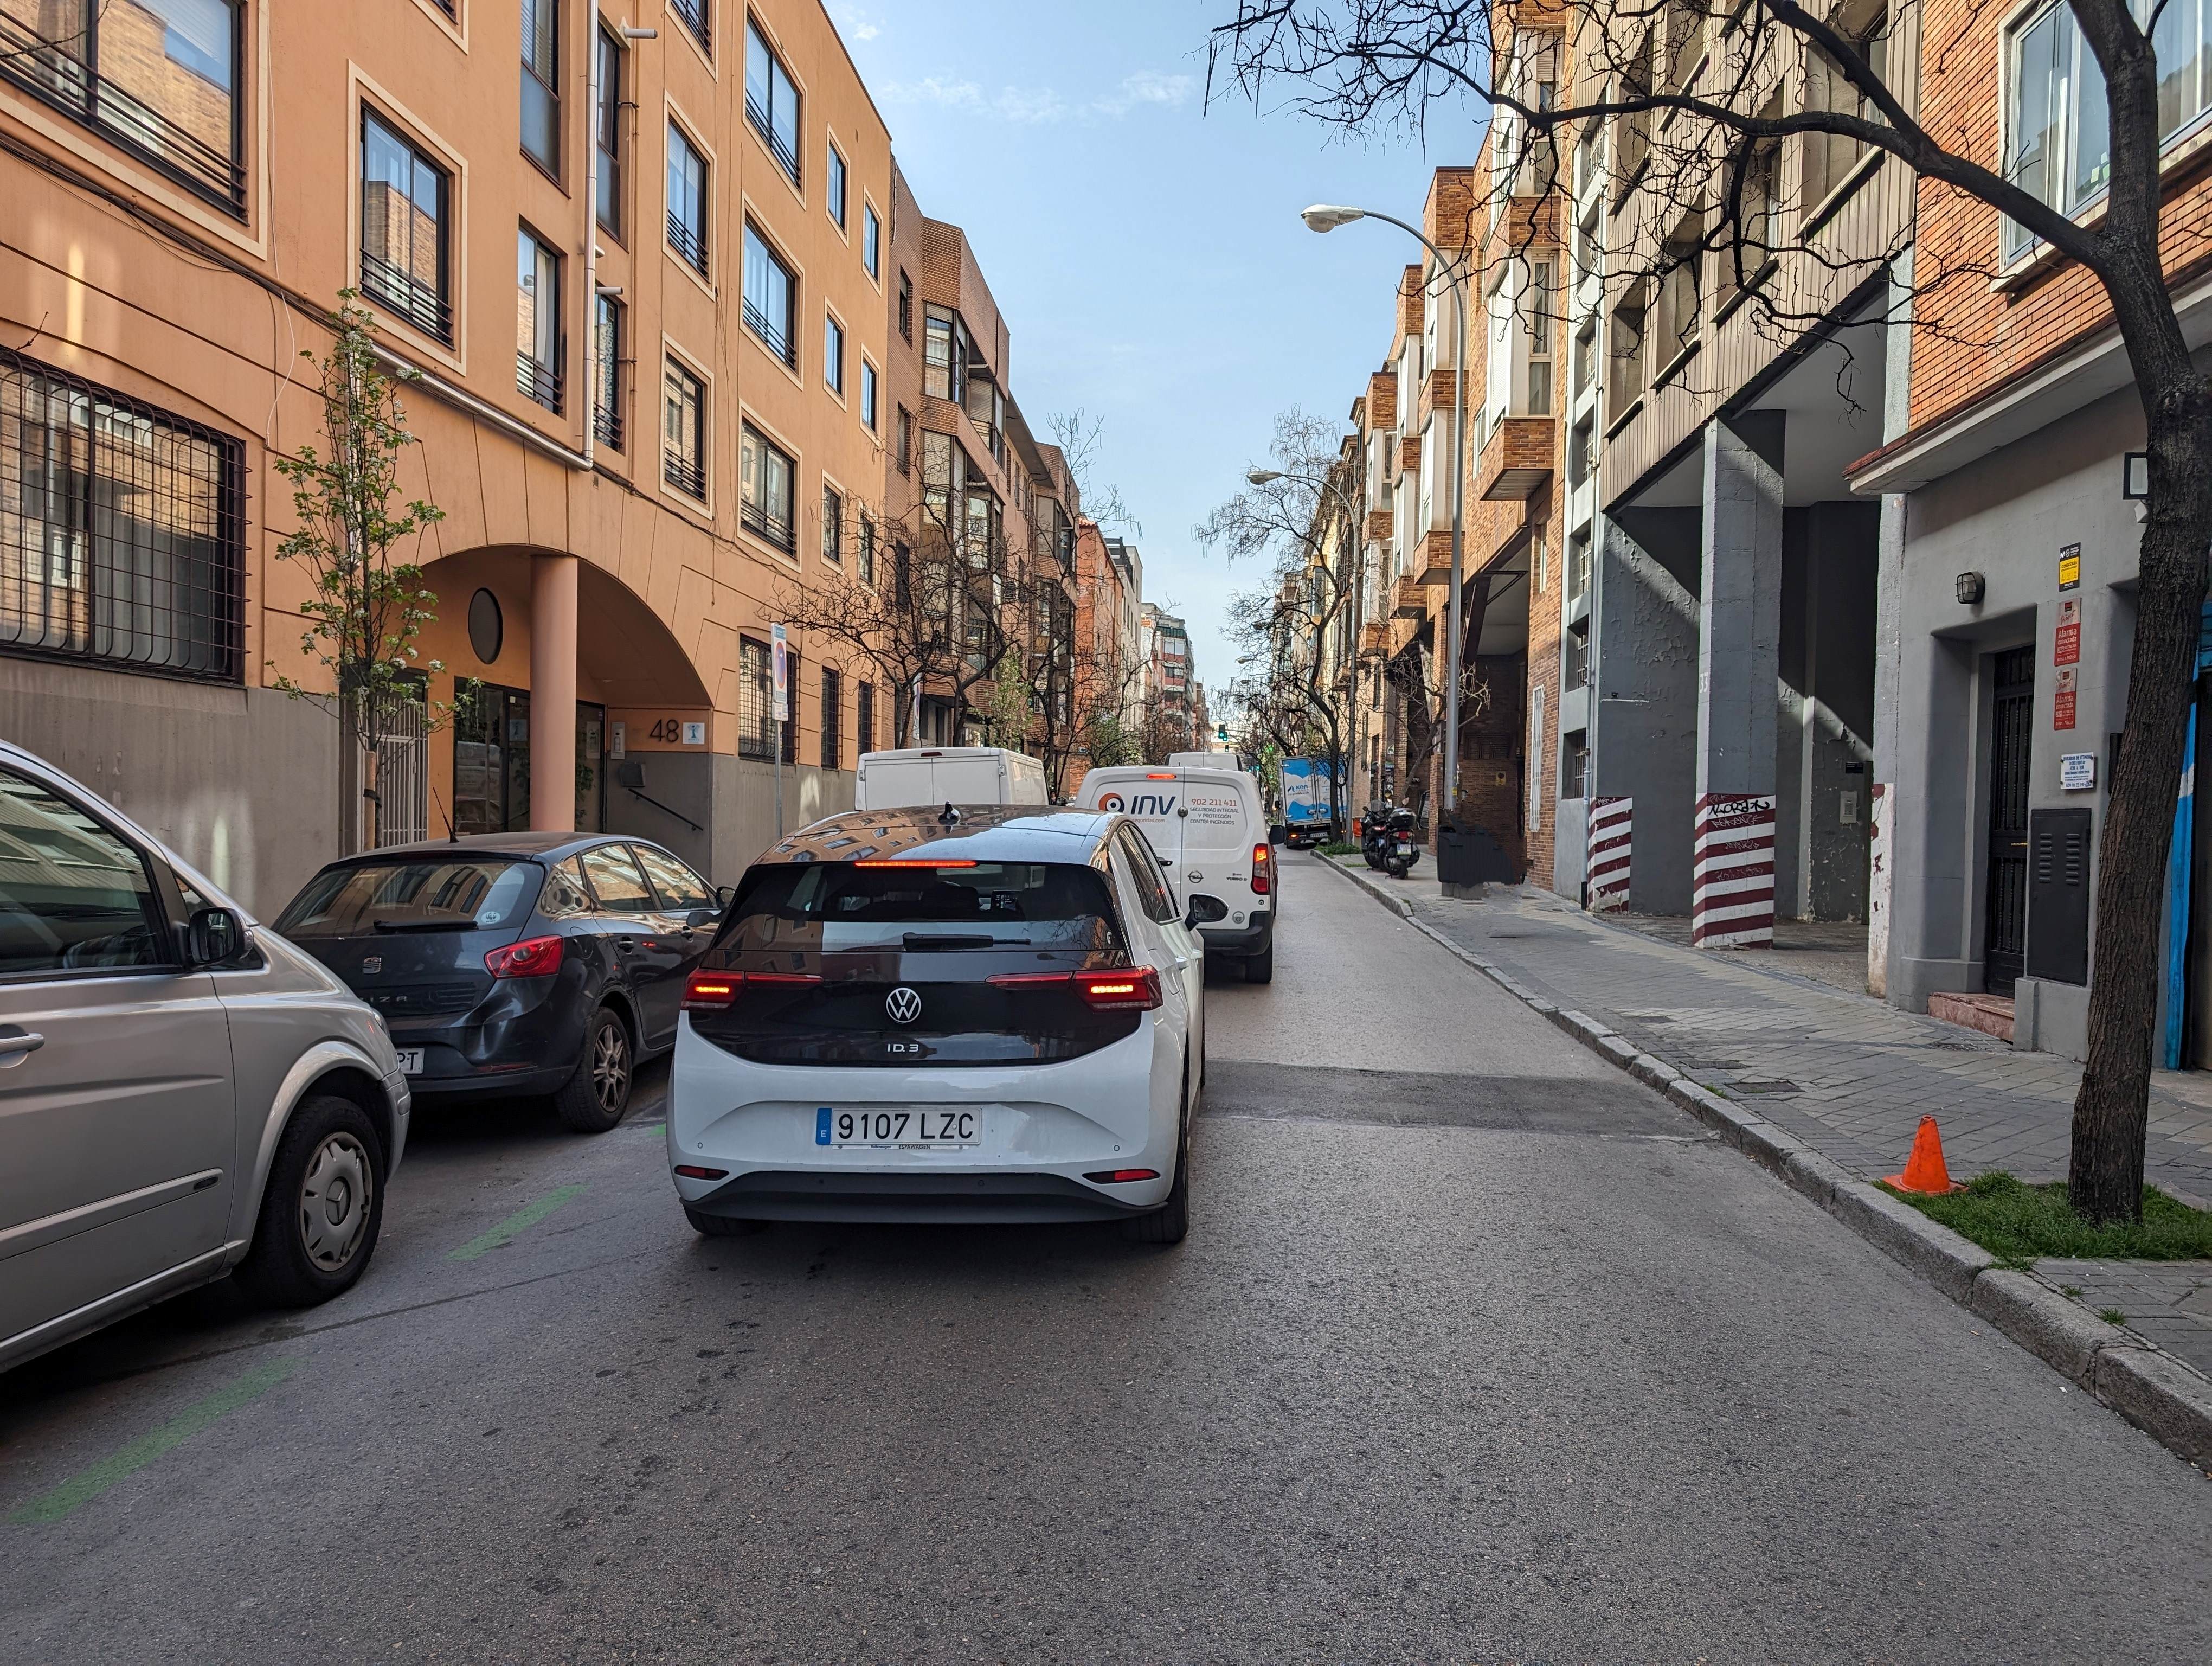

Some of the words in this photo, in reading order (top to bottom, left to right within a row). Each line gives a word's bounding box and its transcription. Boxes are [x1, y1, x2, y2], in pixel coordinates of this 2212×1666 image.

[2057, 636, 2077, 645] conectada
[2059, 628, 2077, 638] Alarma
[1700, 672, 1708, 693] 33
[650, 719, 679, 743] 48
[838, 1113, 910, 1139] 9107
[920, 1113, 974, 1139] LZC
